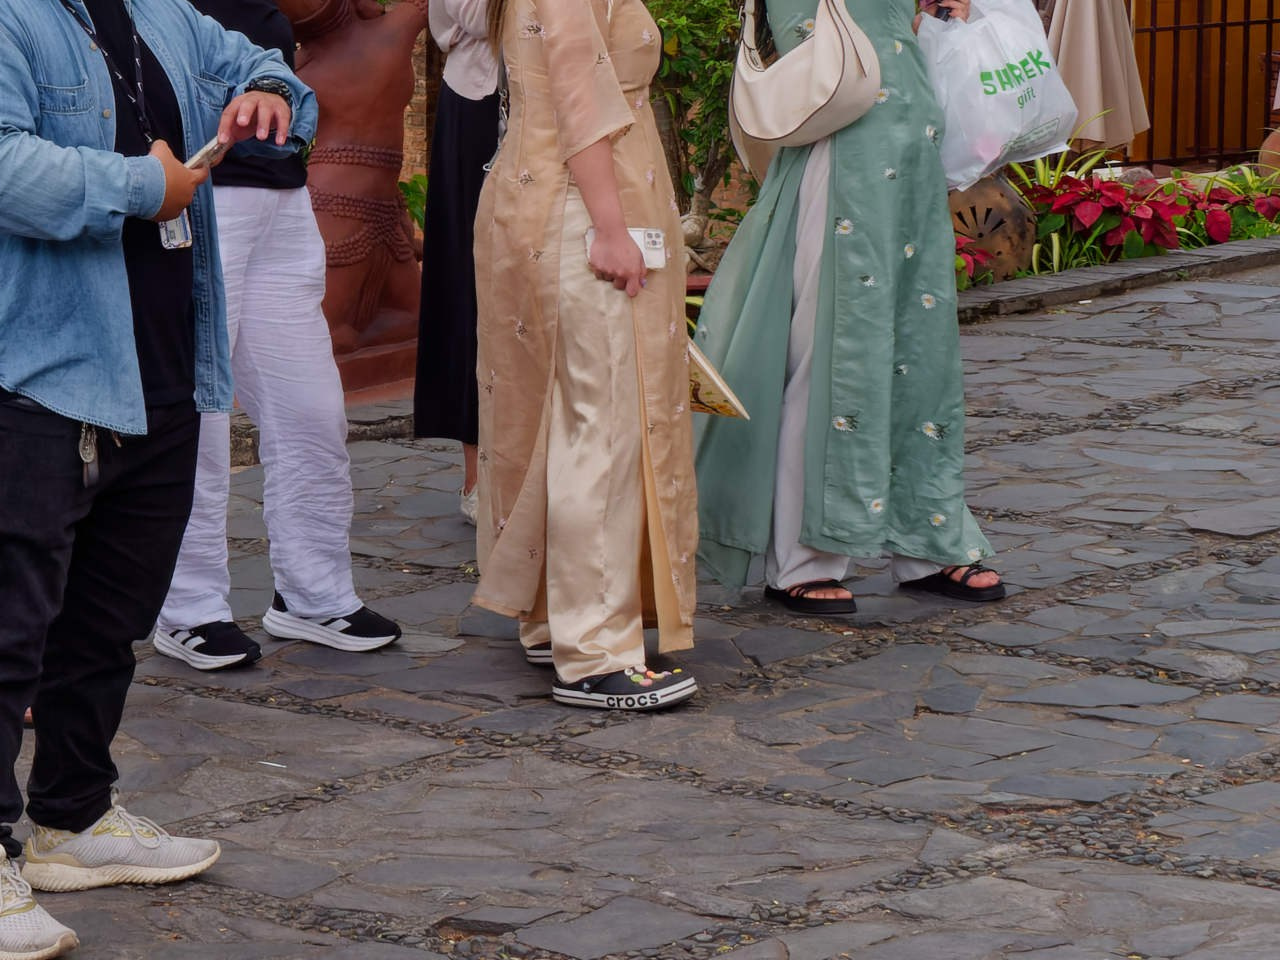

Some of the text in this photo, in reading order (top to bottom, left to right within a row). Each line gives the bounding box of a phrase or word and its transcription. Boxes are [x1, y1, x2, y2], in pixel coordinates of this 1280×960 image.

[980, 49, 1051, 95] SHREK
[1017, 86, 1036, 109] gift
[606, 693, 660, 708] crocs
